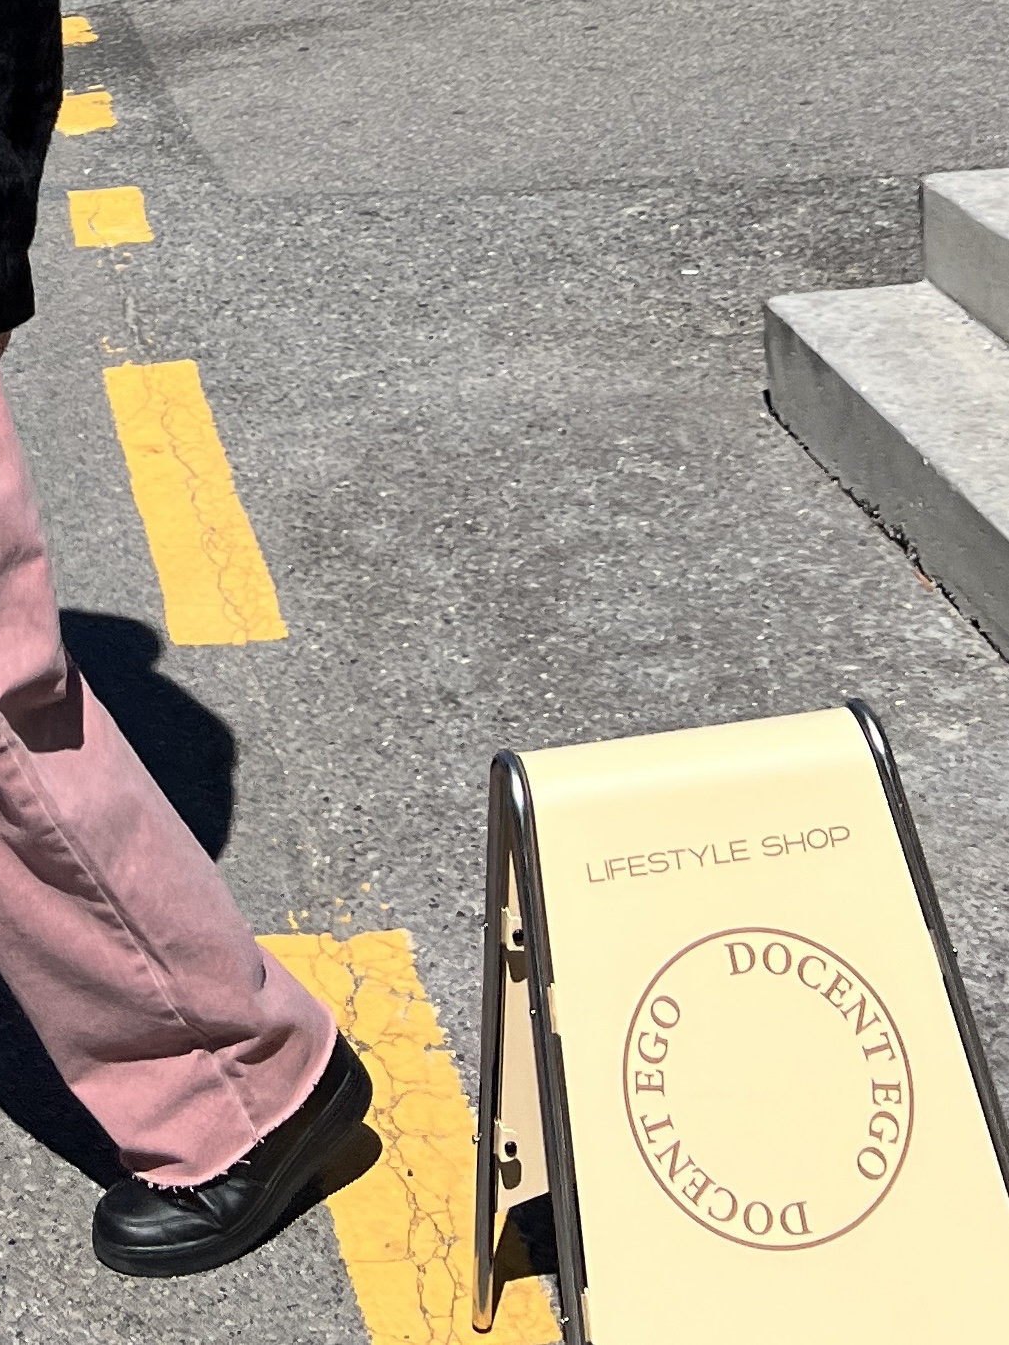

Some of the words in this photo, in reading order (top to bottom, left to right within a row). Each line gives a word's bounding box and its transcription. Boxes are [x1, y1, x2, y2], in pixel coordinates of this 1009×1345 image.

[586, 839, 751, 883] LIFESTYLE
[761, 825, 850, 857] SHOP
[634, 995, 681, 1097] EGO
[724, 941, 897, 1062] DOCENT
[857, 1077, 903, 1181] EGO
[639, 1114, 813, 1236] DOCENT
